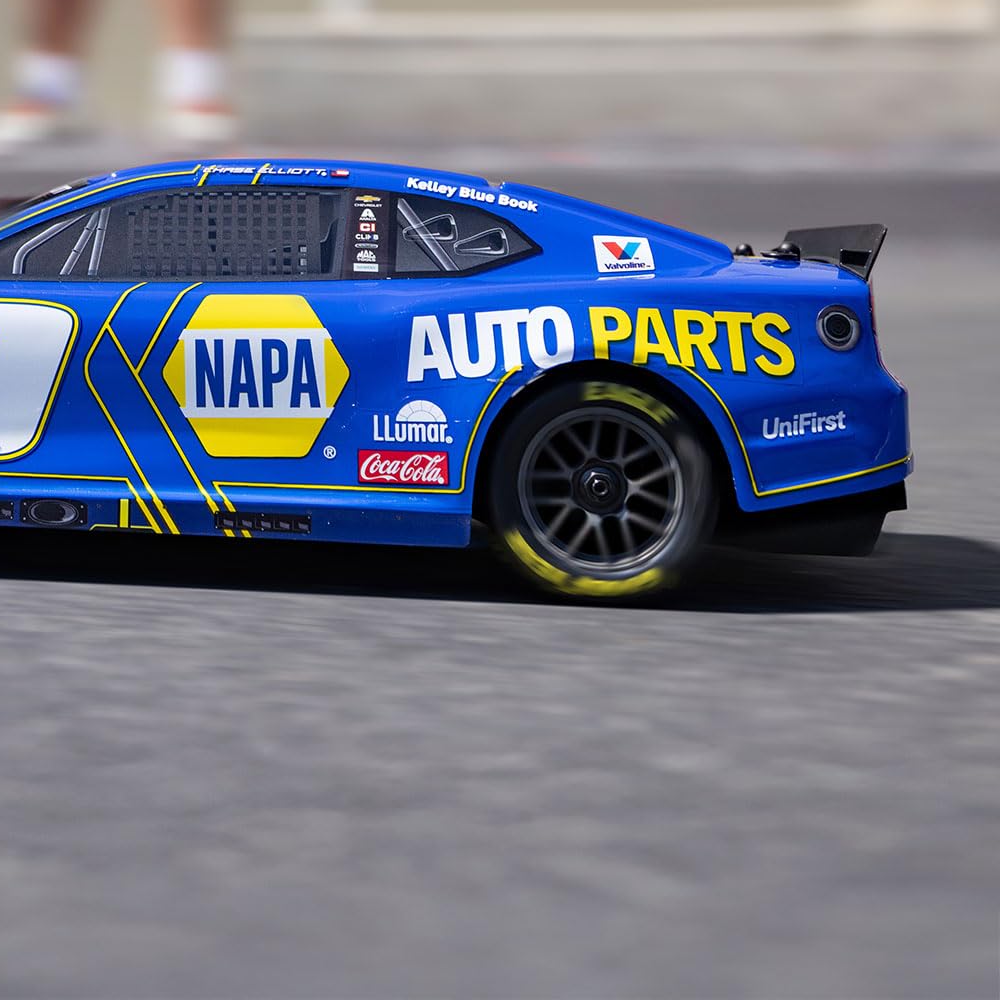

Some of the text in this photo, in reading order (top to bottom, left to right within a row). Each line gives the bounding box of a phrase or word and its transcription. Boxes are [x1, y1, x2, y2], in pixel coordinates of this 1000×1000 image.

[202, 166, 323, 176] CHASE ELLIOTT
[406, 177, 539, 212] Kelley Blue Book
[604, 261, 646, 270] Valvoline
[406, 305, 797, 383] AUTO PARTS
[194, 338, 324, 409] NAPA
[372, 414, 449, 443] LLumar
[762, 410, 847, 440] UniFirst
[360, 452, 446, 484] Coca-Cola
